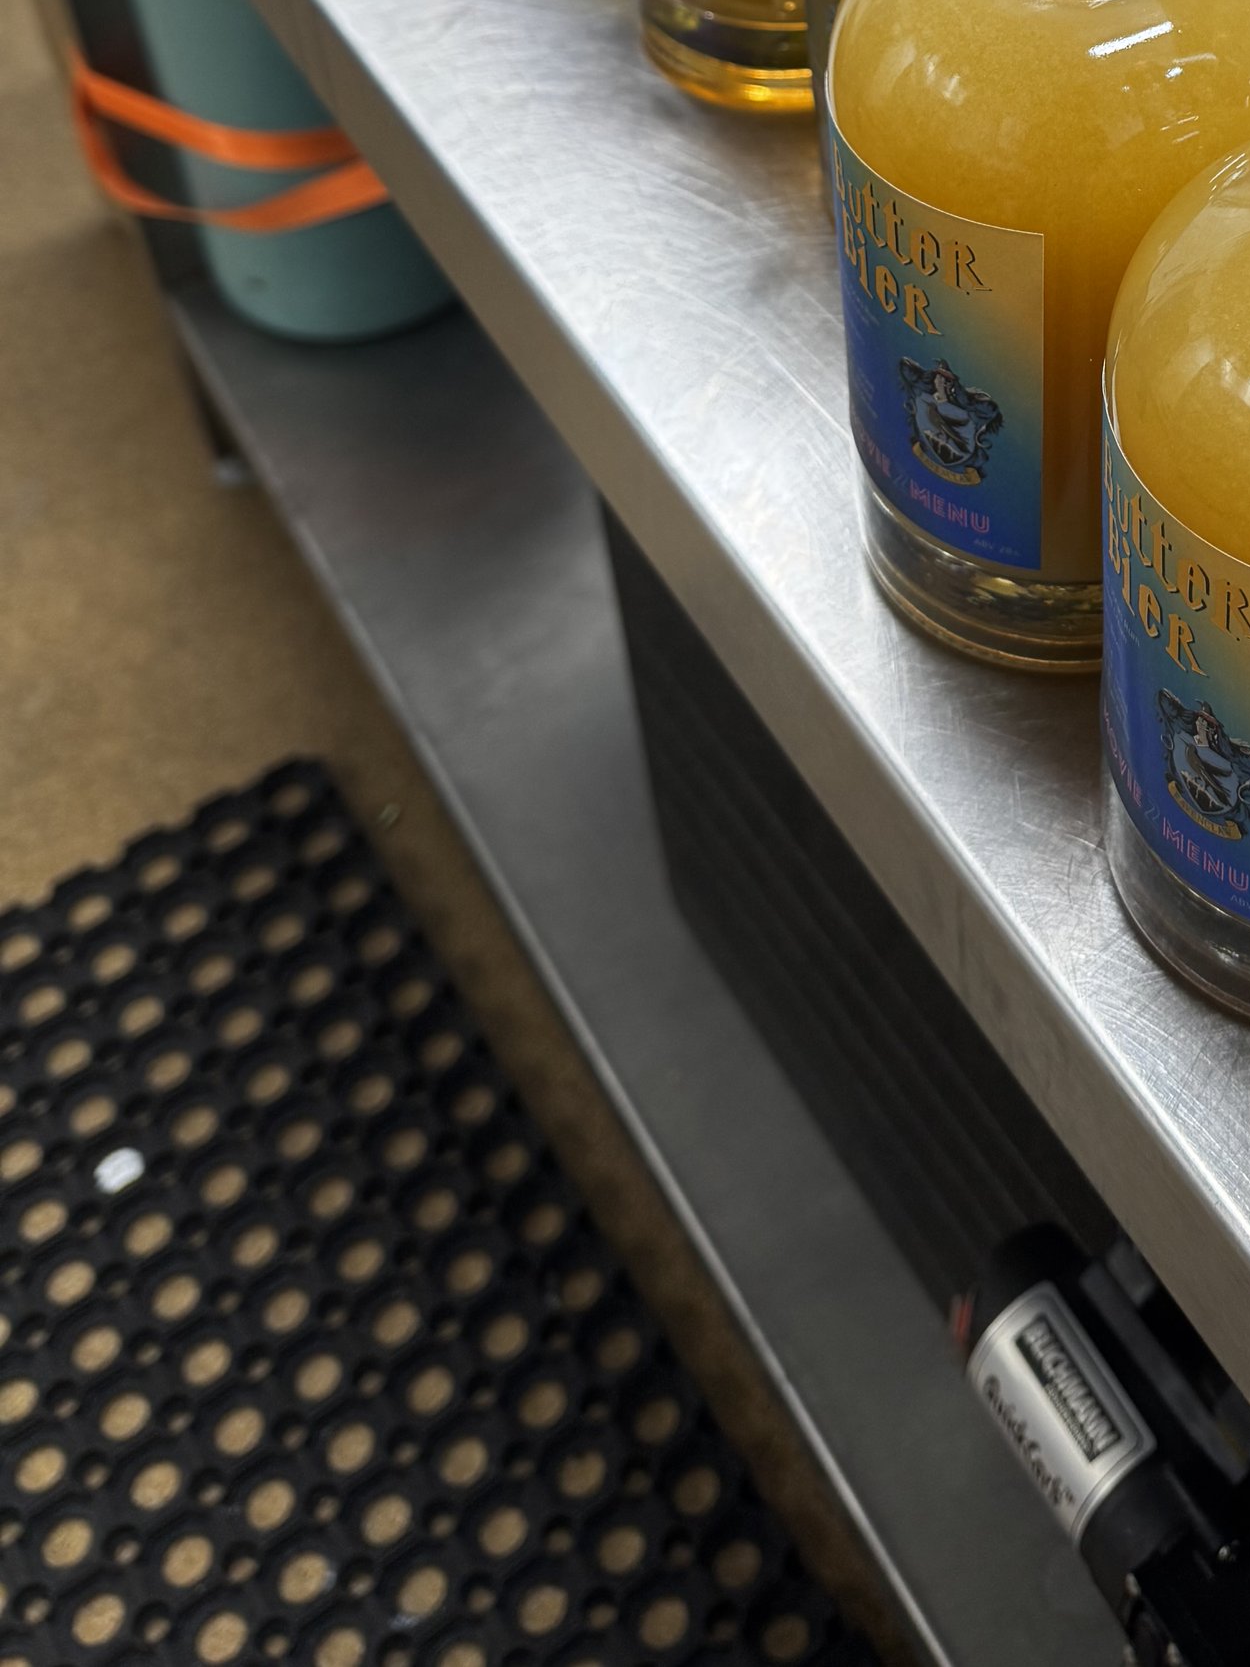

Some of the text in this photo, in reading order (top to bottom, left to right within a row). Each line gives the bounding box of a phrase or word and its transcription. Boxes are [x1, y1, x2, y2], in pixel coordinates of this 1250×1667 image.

[833, 139, 992, 295] Butter
[841, 207, 942, 336] Bier
[908, 479, 991, 534] MENU
[1108, 499, 1208, 677] Bier
[1162, 816, 1249, 892] MENU
